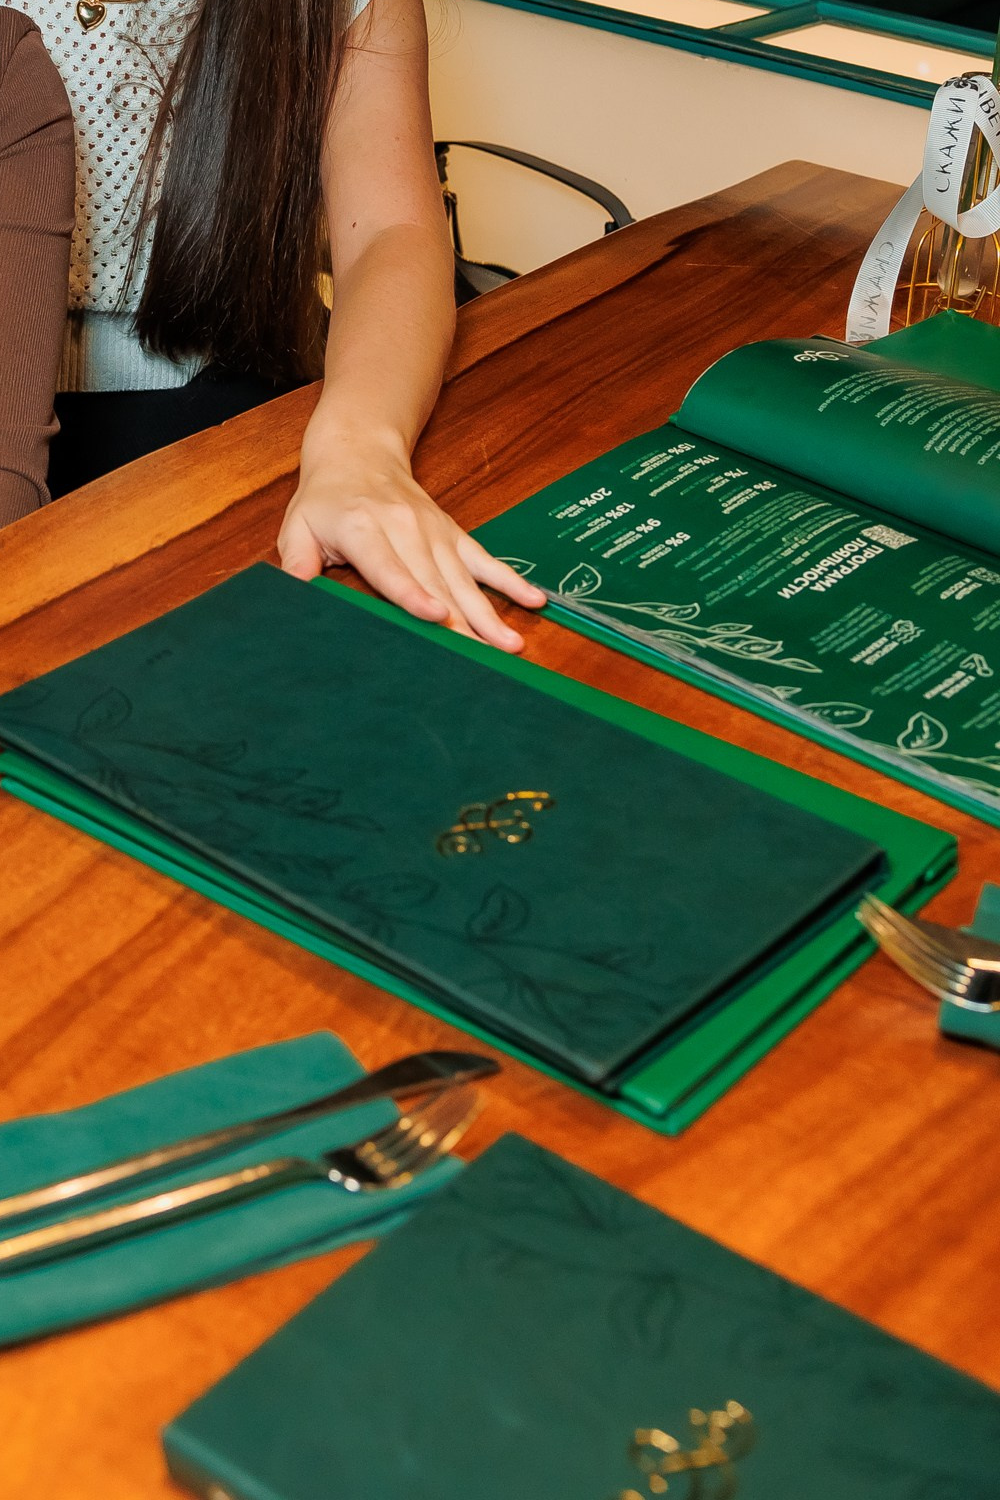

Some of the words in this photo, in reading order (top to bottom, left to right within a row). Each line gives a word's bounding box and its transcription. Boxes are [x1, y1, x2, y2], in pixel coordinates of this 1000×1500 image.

[936, 97, 966, 193] СКАЖИ
[668, 443, 695, 455] 15%
[694, 454, 719, 466] 11%
[724, 468, 748, 478] 7%
[753, 481, 777, 491] 3%
[579, 487, 612, 507] 20%
[605, 502, 635, 519] 13%
[635, 518, 661, 533] 9%
[665, 532, 691, 547] 5%
[777, 537, 868, 599] ЛОЯЛЬНОСТИ
[809, 544, 884, 592] ПРОГРАМА
